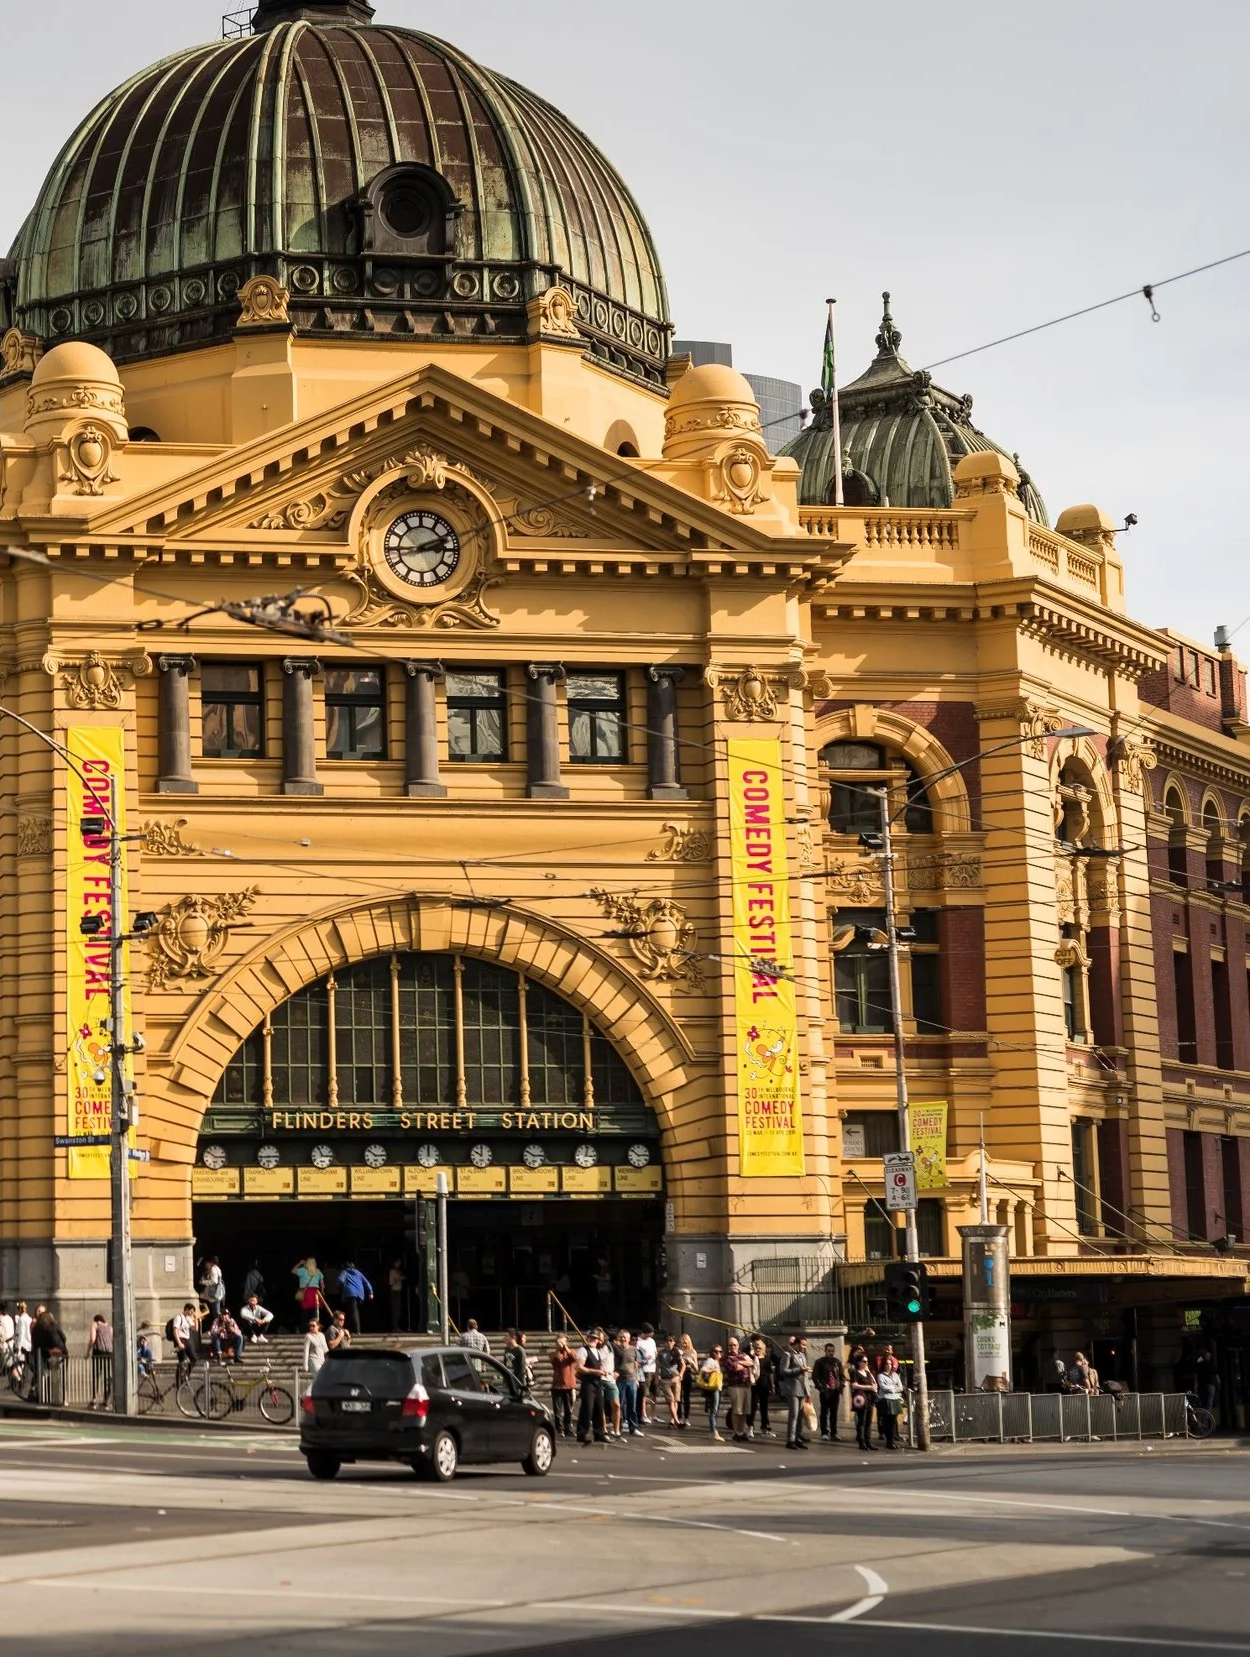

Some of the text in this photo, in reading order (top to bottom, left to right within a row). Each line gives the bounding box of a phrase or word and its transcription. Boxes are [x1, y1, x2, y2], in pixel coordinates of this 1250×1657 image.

[743, 770, 778, 1004] COMEDY FESTIAL
[75, 1087, 88, 1098] 30
[745, 1088, 757, 1099] 30
[745, 1101, 795, 1115] COMEDY
[272, 1112, 593, 1129] FLINDERS STREET STATION
[746, 1116, 796, 1129] FESTIVAL
[913, 1117, 942, 1127] COMEDY
[913, 1127, 942, 1136] FESTIVAL
[896, 1174, 905, 1186] C
